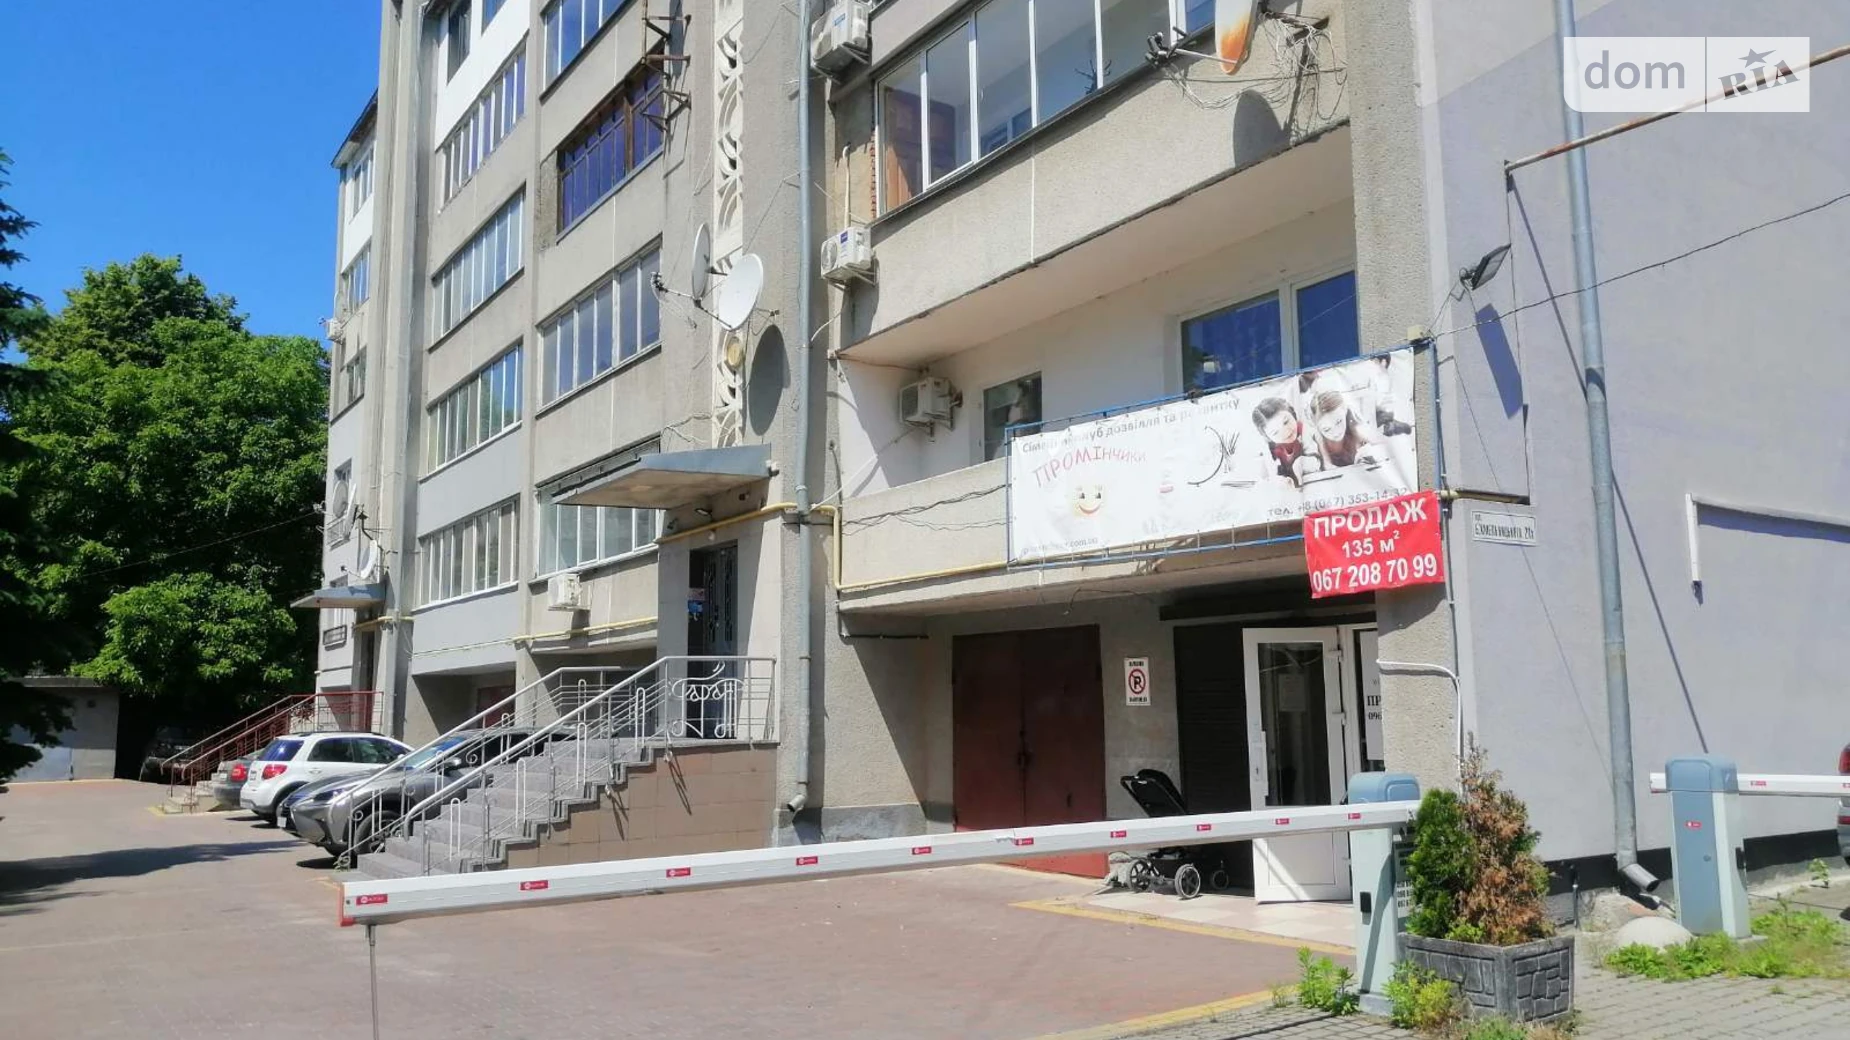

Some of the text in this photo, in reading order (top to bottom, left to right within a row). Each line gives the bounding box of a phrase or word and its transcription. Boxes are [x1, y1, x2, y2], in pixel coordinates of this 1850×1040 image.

[1105, 415, 1160, 438] дозвілля
[1180, 398, 1240, 423] ровитку
[1267, 507, 1293, 516] тел.
[1314, 497, 1427, 539] ПРОДАЖ
[1342, 537, 1374, 558] 135
[1312, 553, 1437, 592] 067 208 70 99
